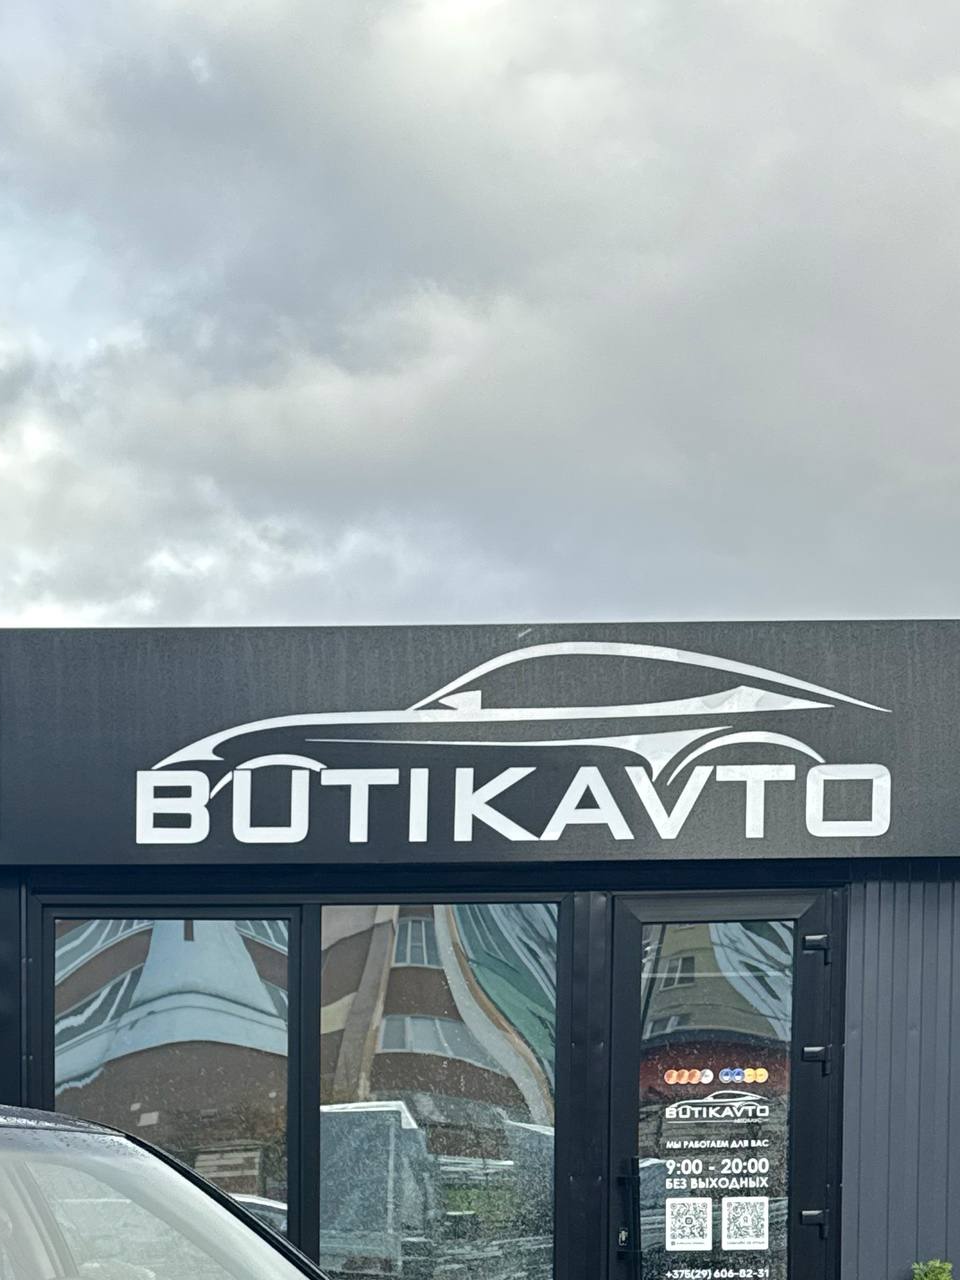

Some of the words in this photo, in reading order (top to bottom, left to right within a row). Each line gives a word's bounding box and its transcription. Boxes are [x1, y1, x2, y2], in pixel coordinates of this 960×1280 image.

[135, 763, 892, 845] BUTIKAVTO
[665, 1105, 769, 1118] BUTIKAVTO
[684, 1140, 729, 1149] РАБОТАЕМ
[730, 1140, 749, 1149] ДЛЯ
[751, 1140, 769, 1148] ВАС
[666, 1159, 703, 1175] 9:00
[720, 1157, 769, 1174] 20:00
[665, 1178, 688, 1189] БЕЗ
[690, 1176, 769, 1189] ВЫХОДНЫХ
[665, 1268, 712, 1280] +375(29)
[713, 1268, 770, 1279] 606-82-31
